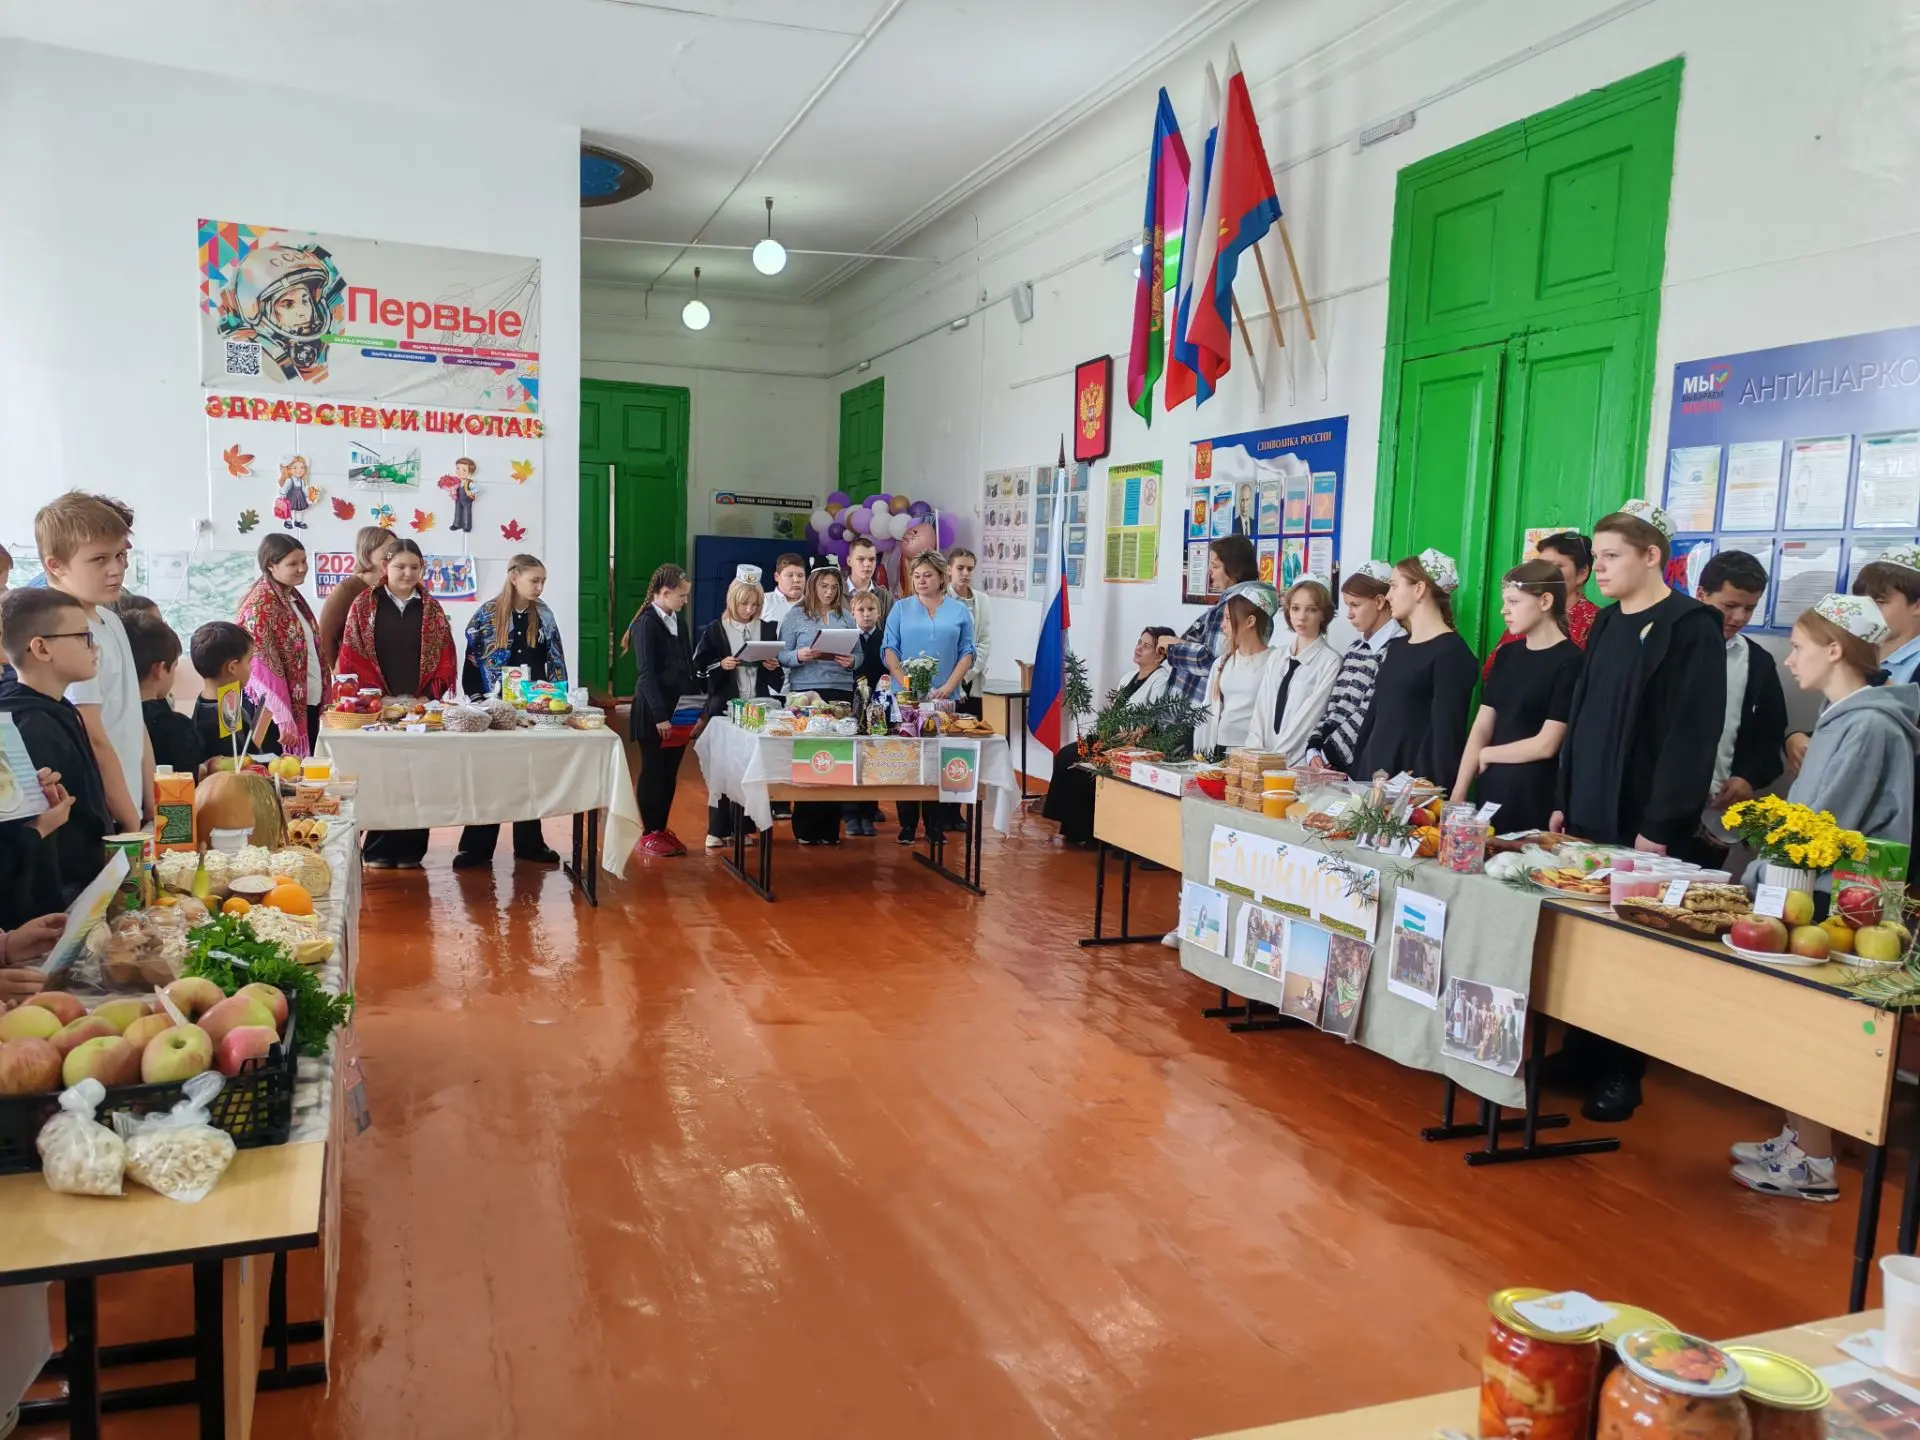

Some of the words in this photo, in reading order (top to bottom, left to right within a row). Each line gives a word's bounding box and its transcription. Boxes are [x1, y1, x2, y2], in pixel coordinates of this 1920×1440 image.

[270, 253, 307, 267] ССС
[348, 286, 523, 339] Первые
[1683, 374, 1715, 394] МЫ
[206, 395, 420, 432] ЗДРАВСТВУЙ
[425, 409, 535, 439] ШКОЛА!
[1257, 436, 1299, 451] СИМВОЛИКА
[1300, 431, 1332, 445] РОССИИ
[318, 554, 357, 573] 202
[318, 574, 337, 585] ГОД
[1212, 842, 1376, 911] БАШКИР
